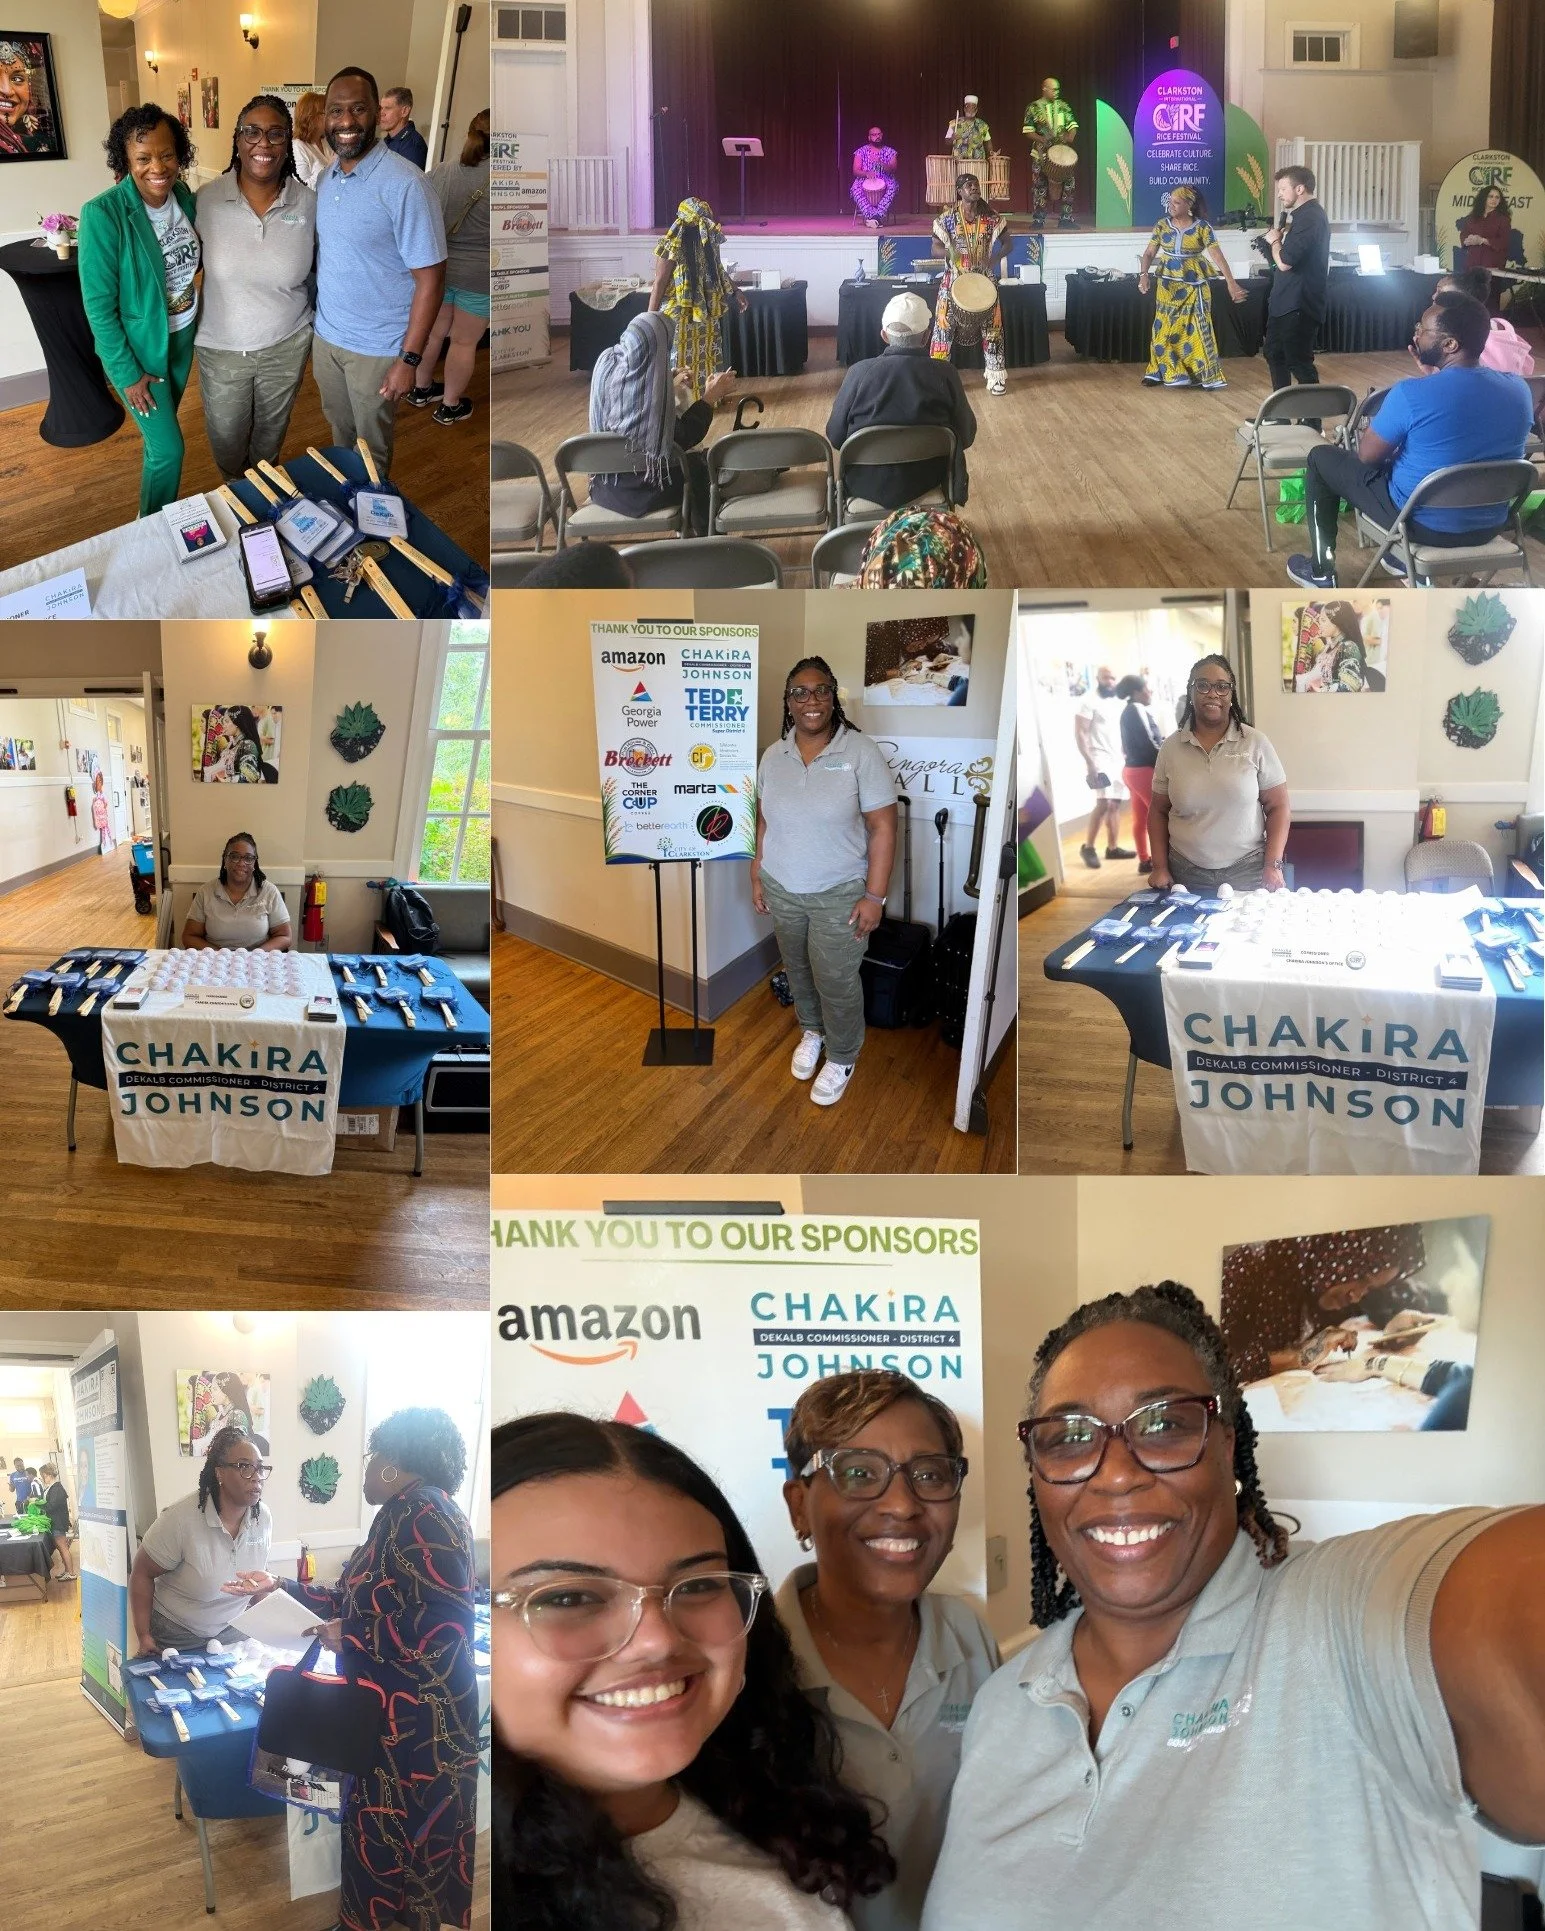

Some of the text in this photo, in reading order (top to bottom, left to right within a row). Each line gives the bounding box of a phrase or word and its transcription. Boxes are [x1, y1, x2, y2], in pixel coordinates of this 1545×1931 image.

[1158, 86, 1202, 96] CLARKSTON
[1172, 132, 1202, 140] FESTIVAL
[1146, 150, 1214, 158] CELEBRATE CULTURE.
[1160, 163, 1200, 172] SHARE RICE.
[1150, 176, 1168, 185] BUILD
[522, 187, 547, 195] amazon
[502, 220, 544, 230] Brockett
[512, 324, 531, 334] YOU
[46, 592, 84, 610] JOHNSON
[591, 624, 758, 638] THANK YOU TO OUR SPONSORS
[602, 651, 666, 664] amazon
[682, 670, 752, 680] JOHNSON
[684, 688, 726, 704] TED
[622, 706, 662, 718] Georgia
[685, 706, 750, 722] TERRY
[626, 718, 658, 728] Power
[604, 750, 673, 768] Brockett
[674, 784, 716, 794] marta
[622, 796, 658, 810] CUP
[1196, 1056, 1247, 1070] DEKALB
[1251, 1061, 1361, 1077] COMMISSIONER
[1376, 1068, 1444, 1086] DISTRICT
[1448, 1077, 1458, 1086] 4
[126, 1075, 166, 1084] DEKALB
[169, 1076, 250, 1086] COMMISSIONER
[262, 1080, 309, 1092] DISTRICT
[121, 1091, 325, 1122] JOHNSON
[1189, 1080, 1465, 1129] JOHNSON
[585, 1220, 659, 1249] YOU
[664, 1221, 713, 1250] TO
[720, 1222, 795, 1251] OUR
[802, 1224, 978, 1255] SPONSORS
[498, 1304, 702, 1341] amazon
[760, 1333, 804, 1342] DEKALB
[806, 1334, 890, 1343] COMMISSIONER
[900, 1334, 945, 1344] DISTRICT
[948, 1335, 955, 1344] 4
[757, 1353, 962, 1379] JOHNSON
